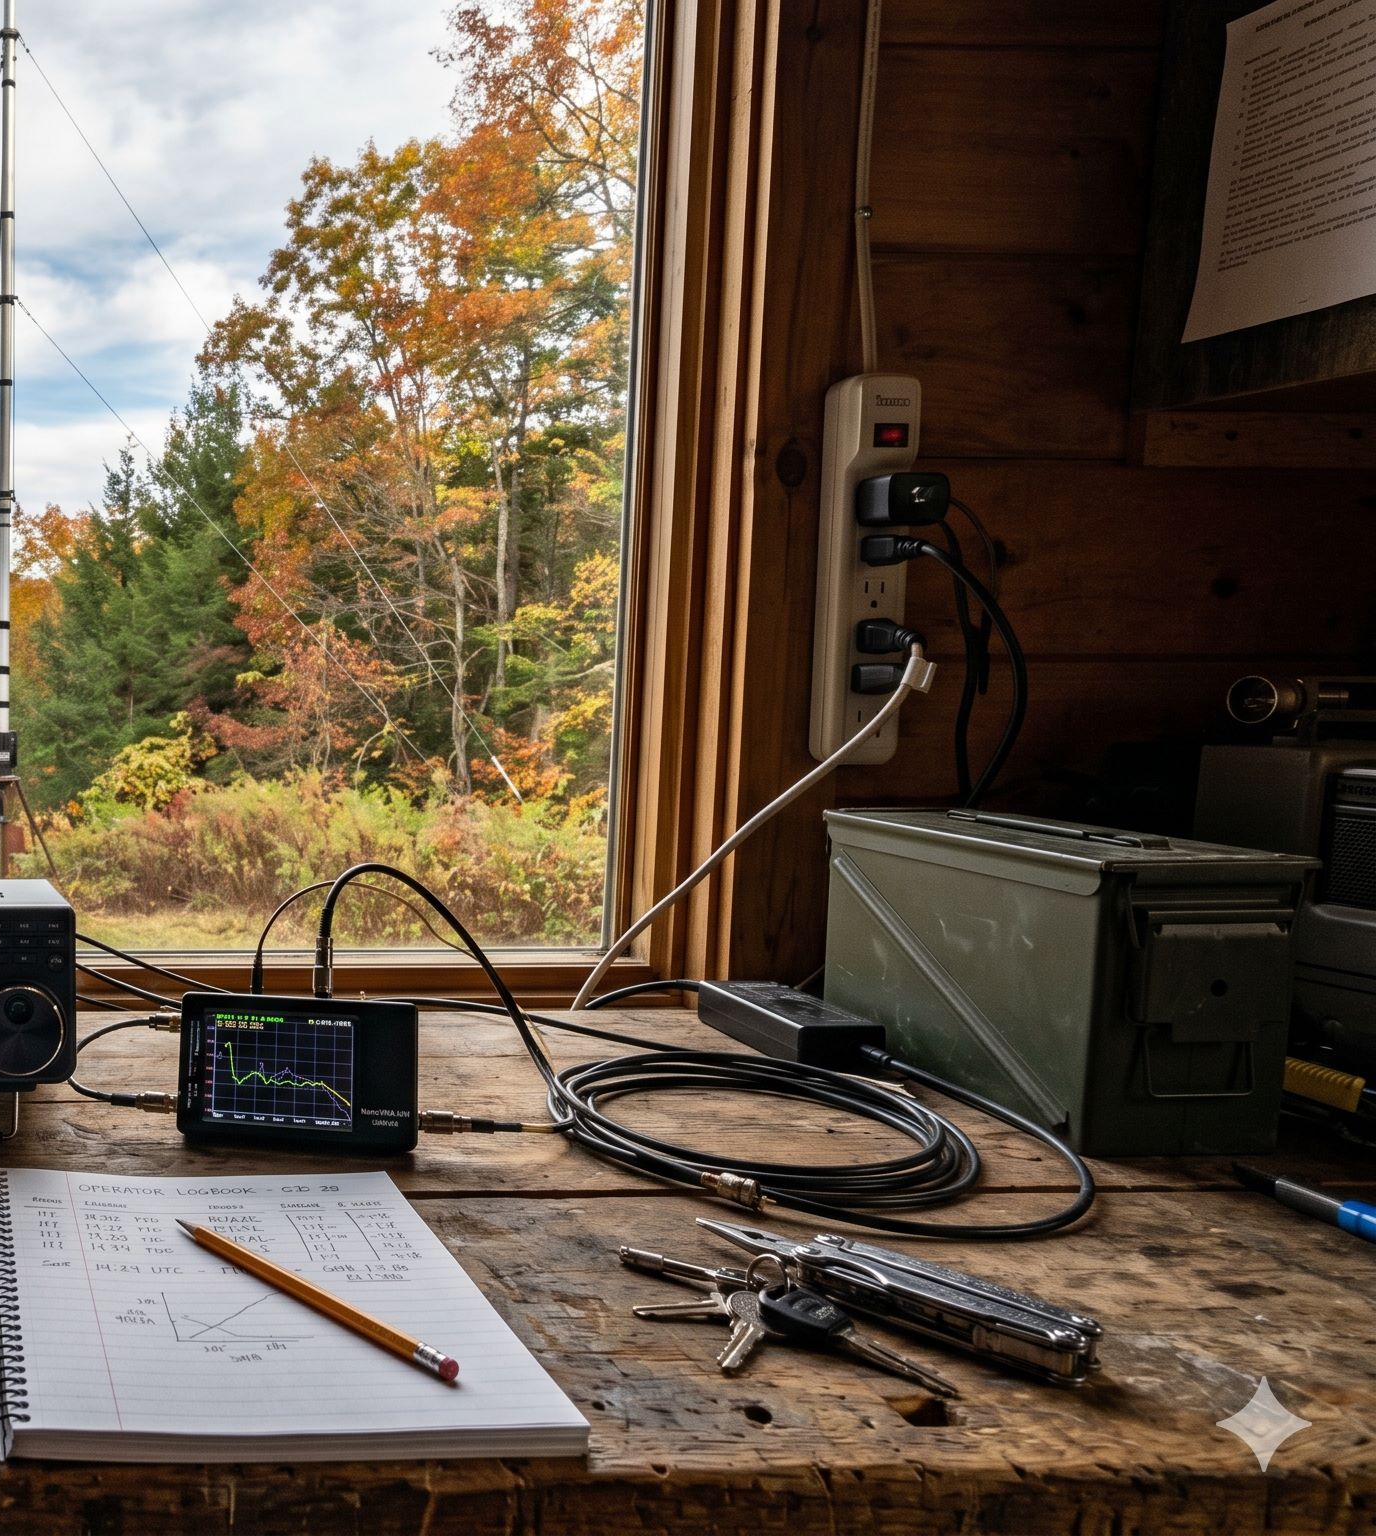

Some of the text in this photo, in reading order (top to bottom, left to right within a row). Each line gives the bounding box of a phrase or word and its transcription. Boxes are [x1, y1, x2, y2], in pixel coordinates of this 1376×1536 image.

[78, 1184, 166, 1197] OPERATOR
[176, 1187, 256, 1196] LOGBOOK
[150, 1266, 184, 1274] UTC
